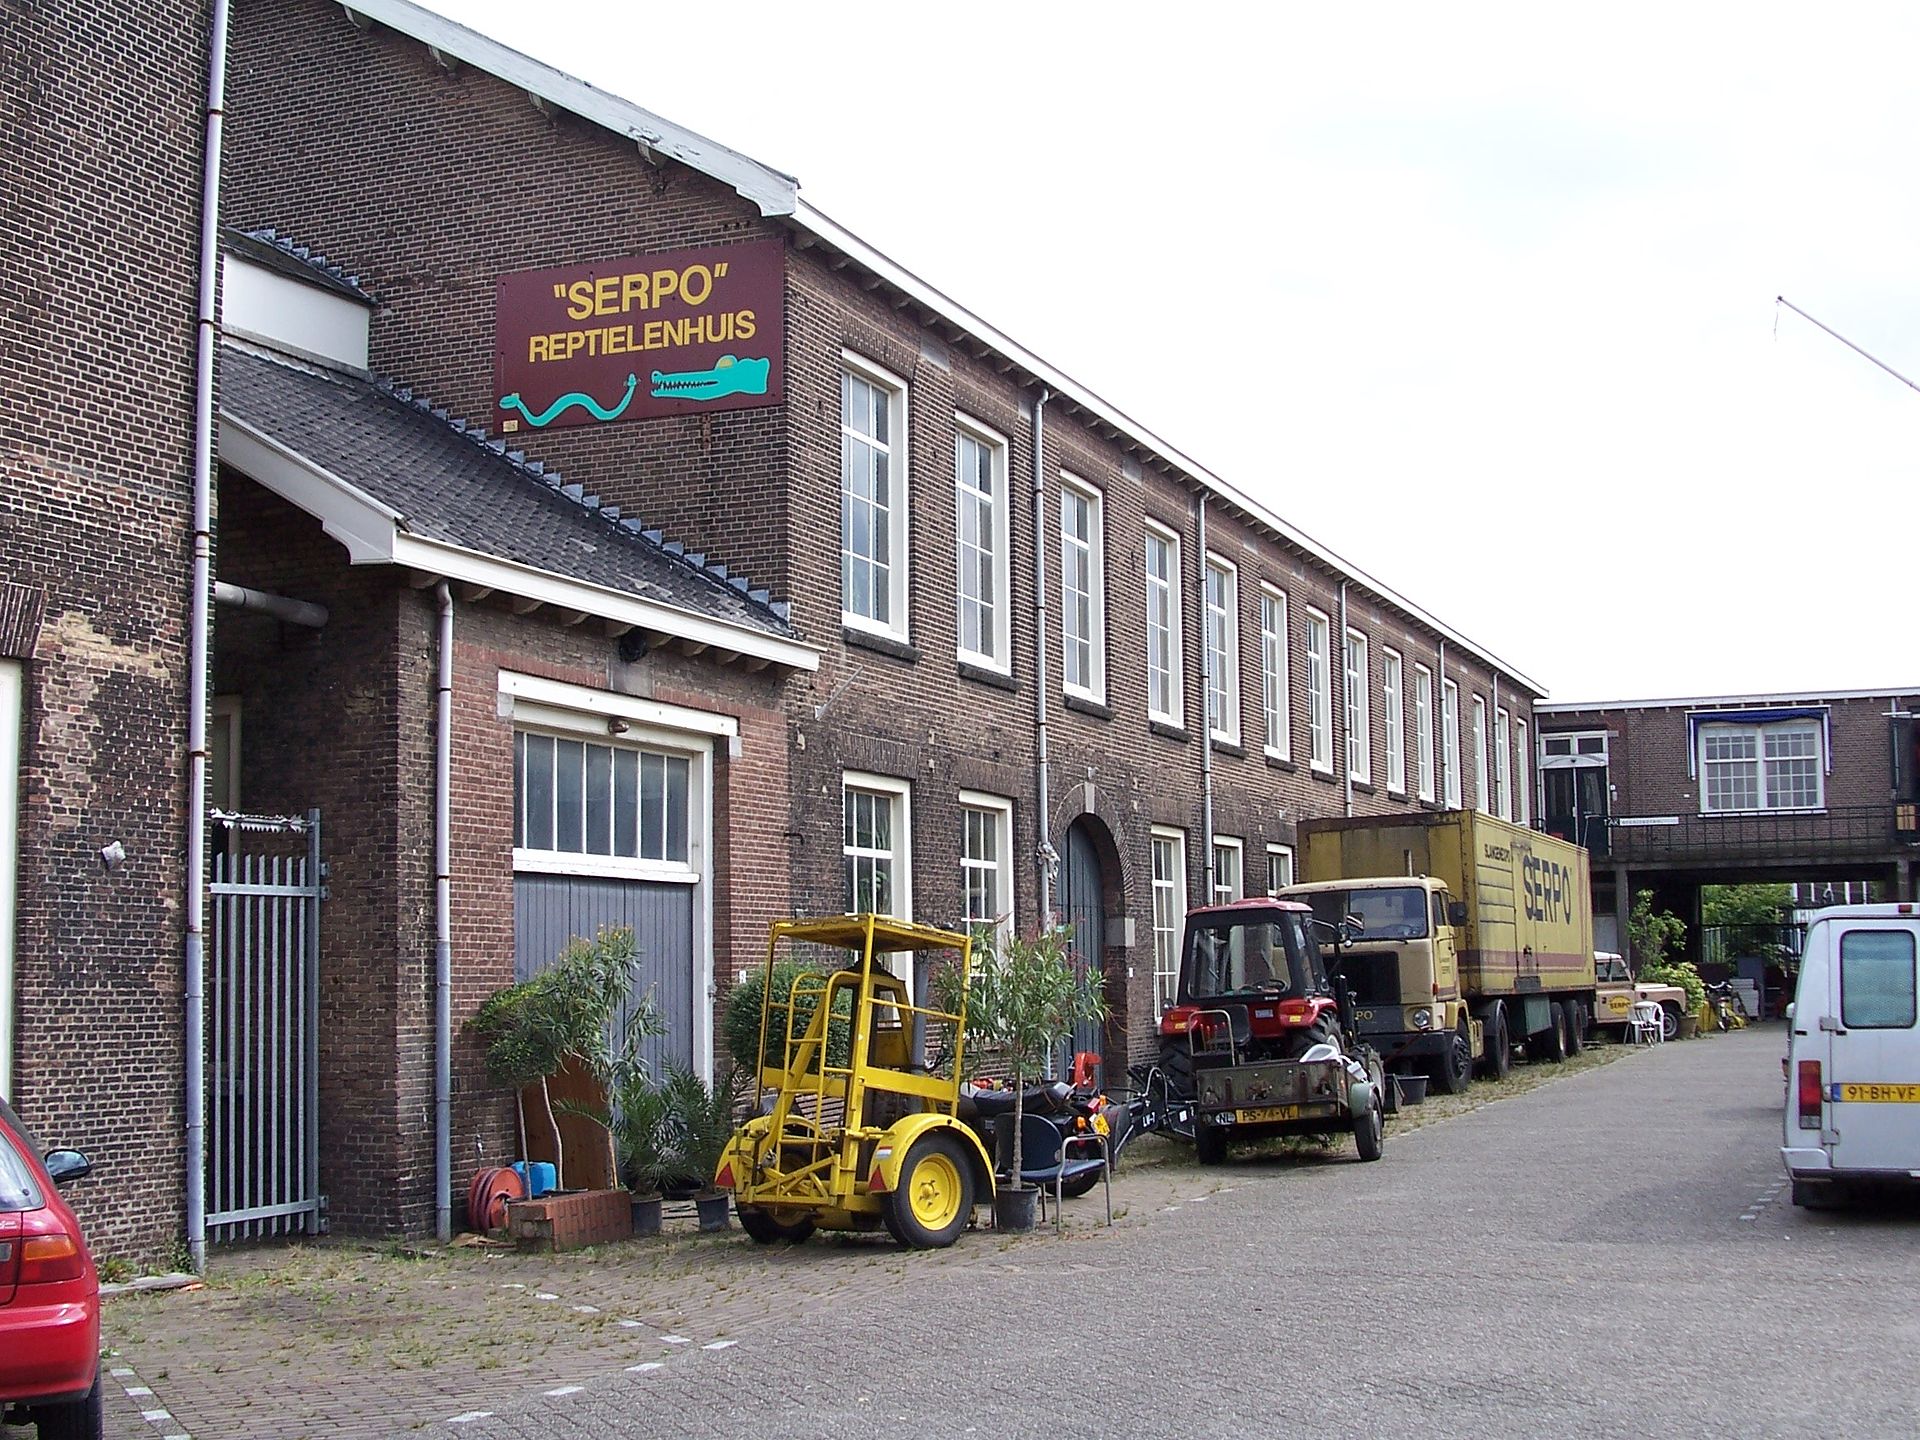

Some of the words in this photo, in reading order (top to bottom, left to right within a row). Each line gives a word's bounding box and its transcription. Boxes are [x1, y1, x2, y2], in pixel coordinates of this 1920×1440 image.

[553, 262, 729, 321] "SERPO"
[528, 310, 756, 363] REPTIELENHUIS
[1522, 854, 1572, 926] SERPO
[1847, 1086, 1917, 1100] 91-BH-VF
